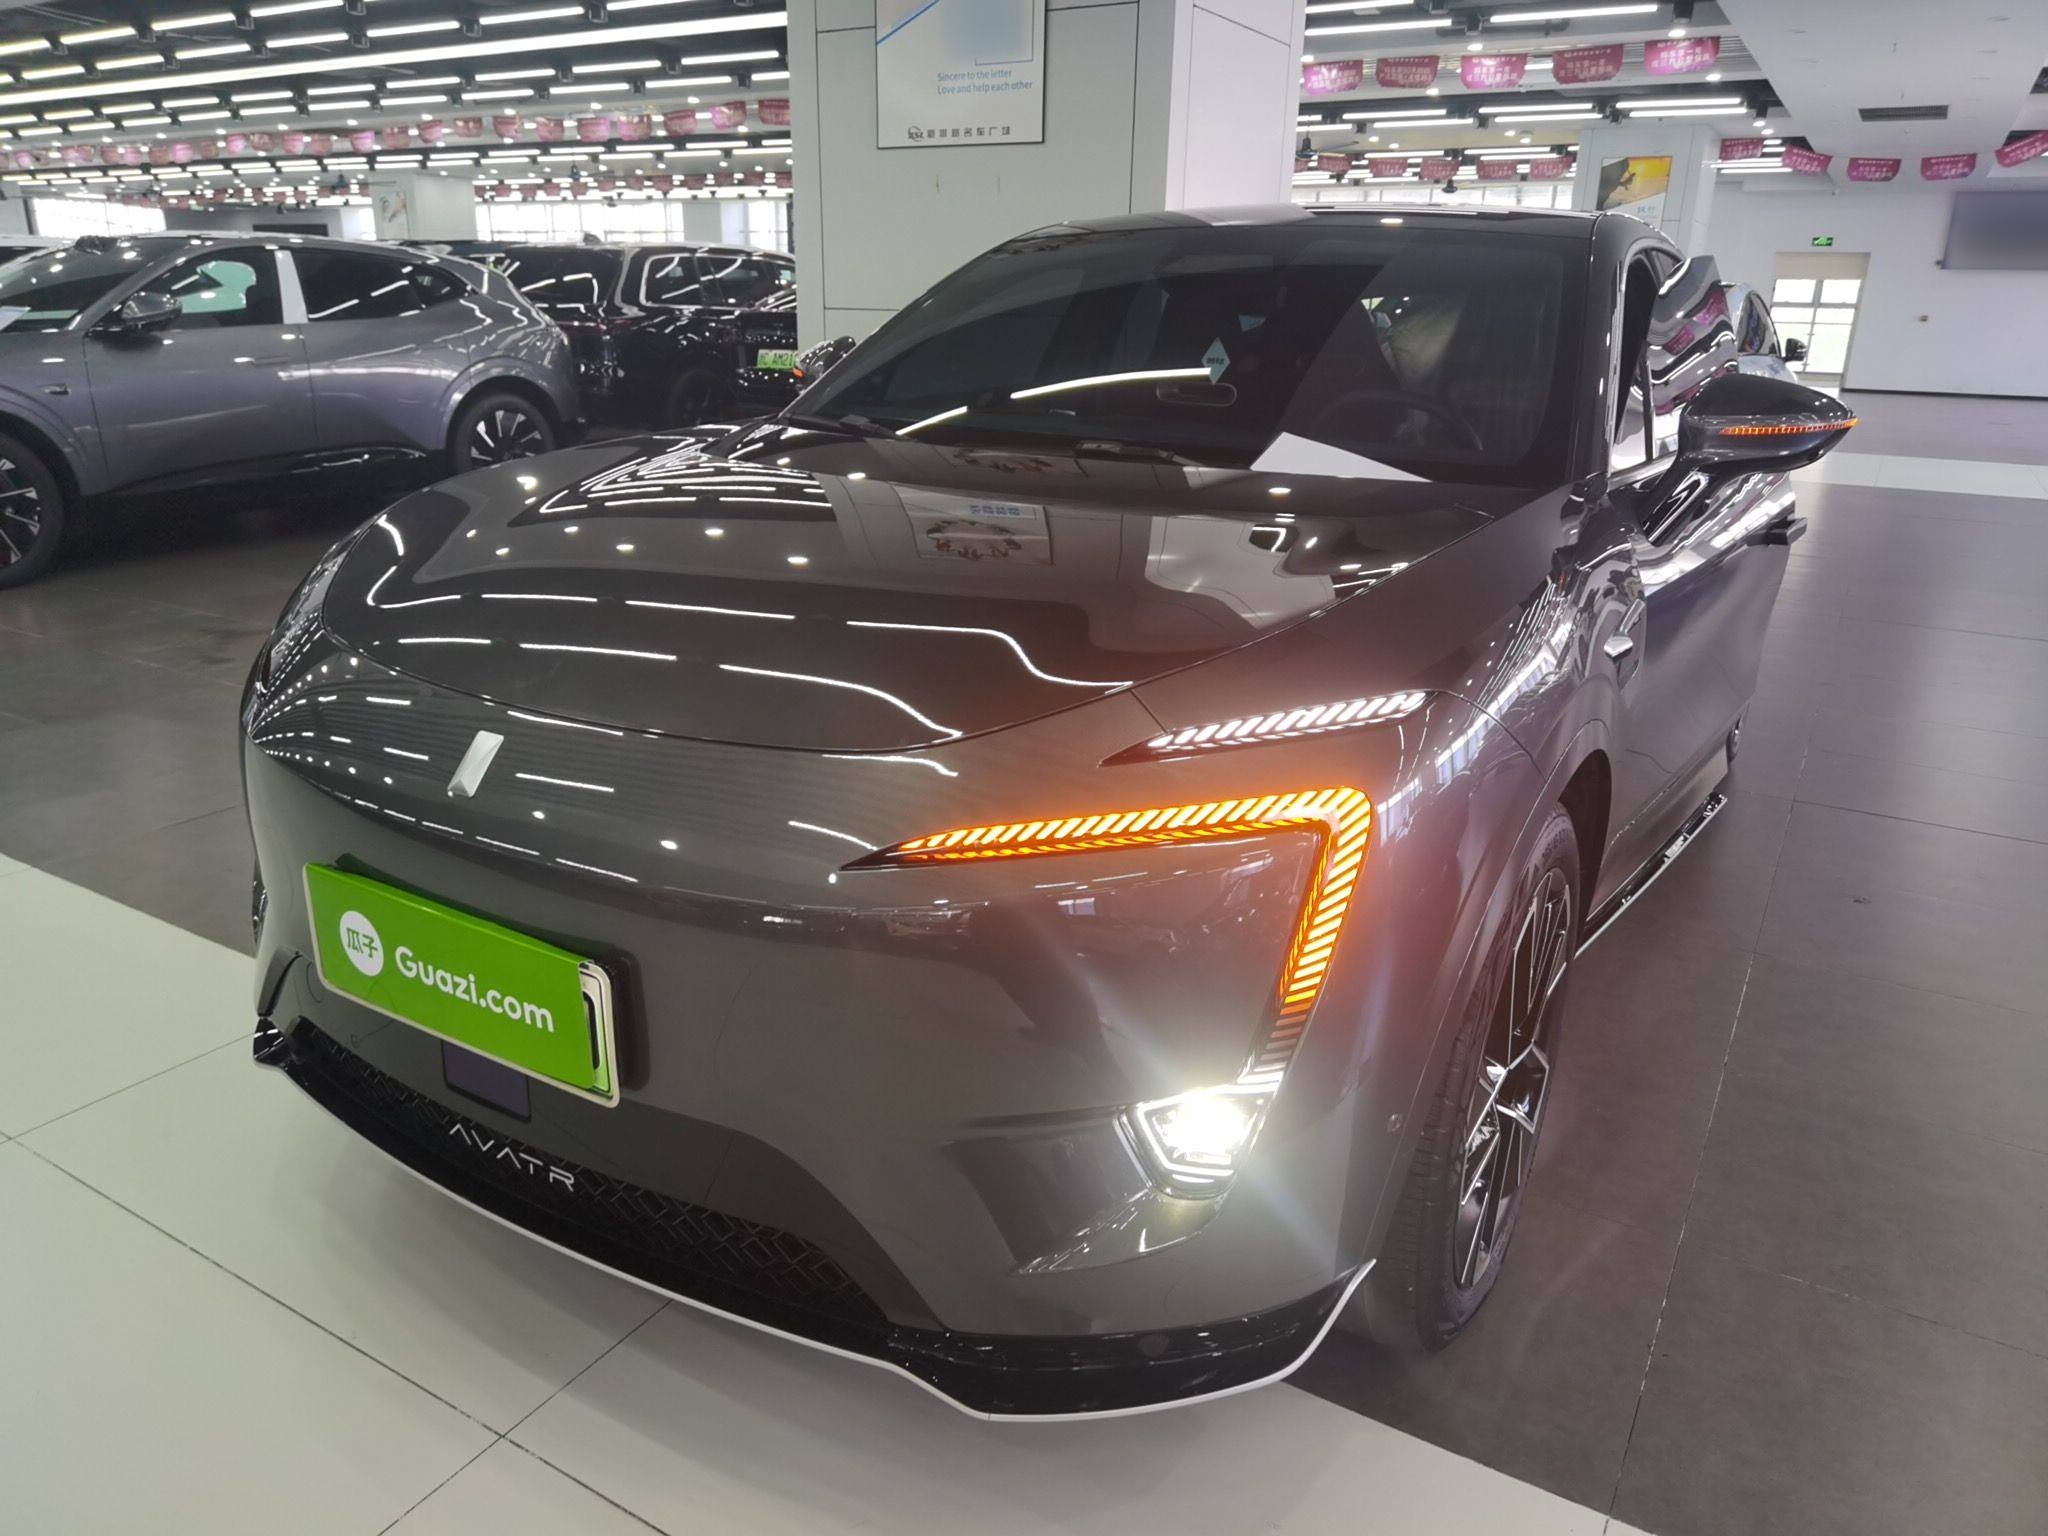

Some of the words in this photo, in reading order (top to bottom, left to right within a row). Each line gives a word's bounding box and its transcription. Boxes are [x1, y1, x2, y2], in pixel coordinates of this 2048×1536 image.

[937, 72, 966, 82] Sincere
[967, 71, 976, 80] to
[976, 70, 990, 79] the
[990, 69, 1012, 79] letter
[937, 85, 957, 95] Love
[957, 84, 972, 93] and
[973, 83, 990, 94] help
[991, 81, 1010, 92] each
[1011, 79, 1033, 90] other
[346, 927, 378, 959] 瓜子
[395, 945, 555, 1033] Guazi.com
[448, 1122, 575, 1193] AVATR
